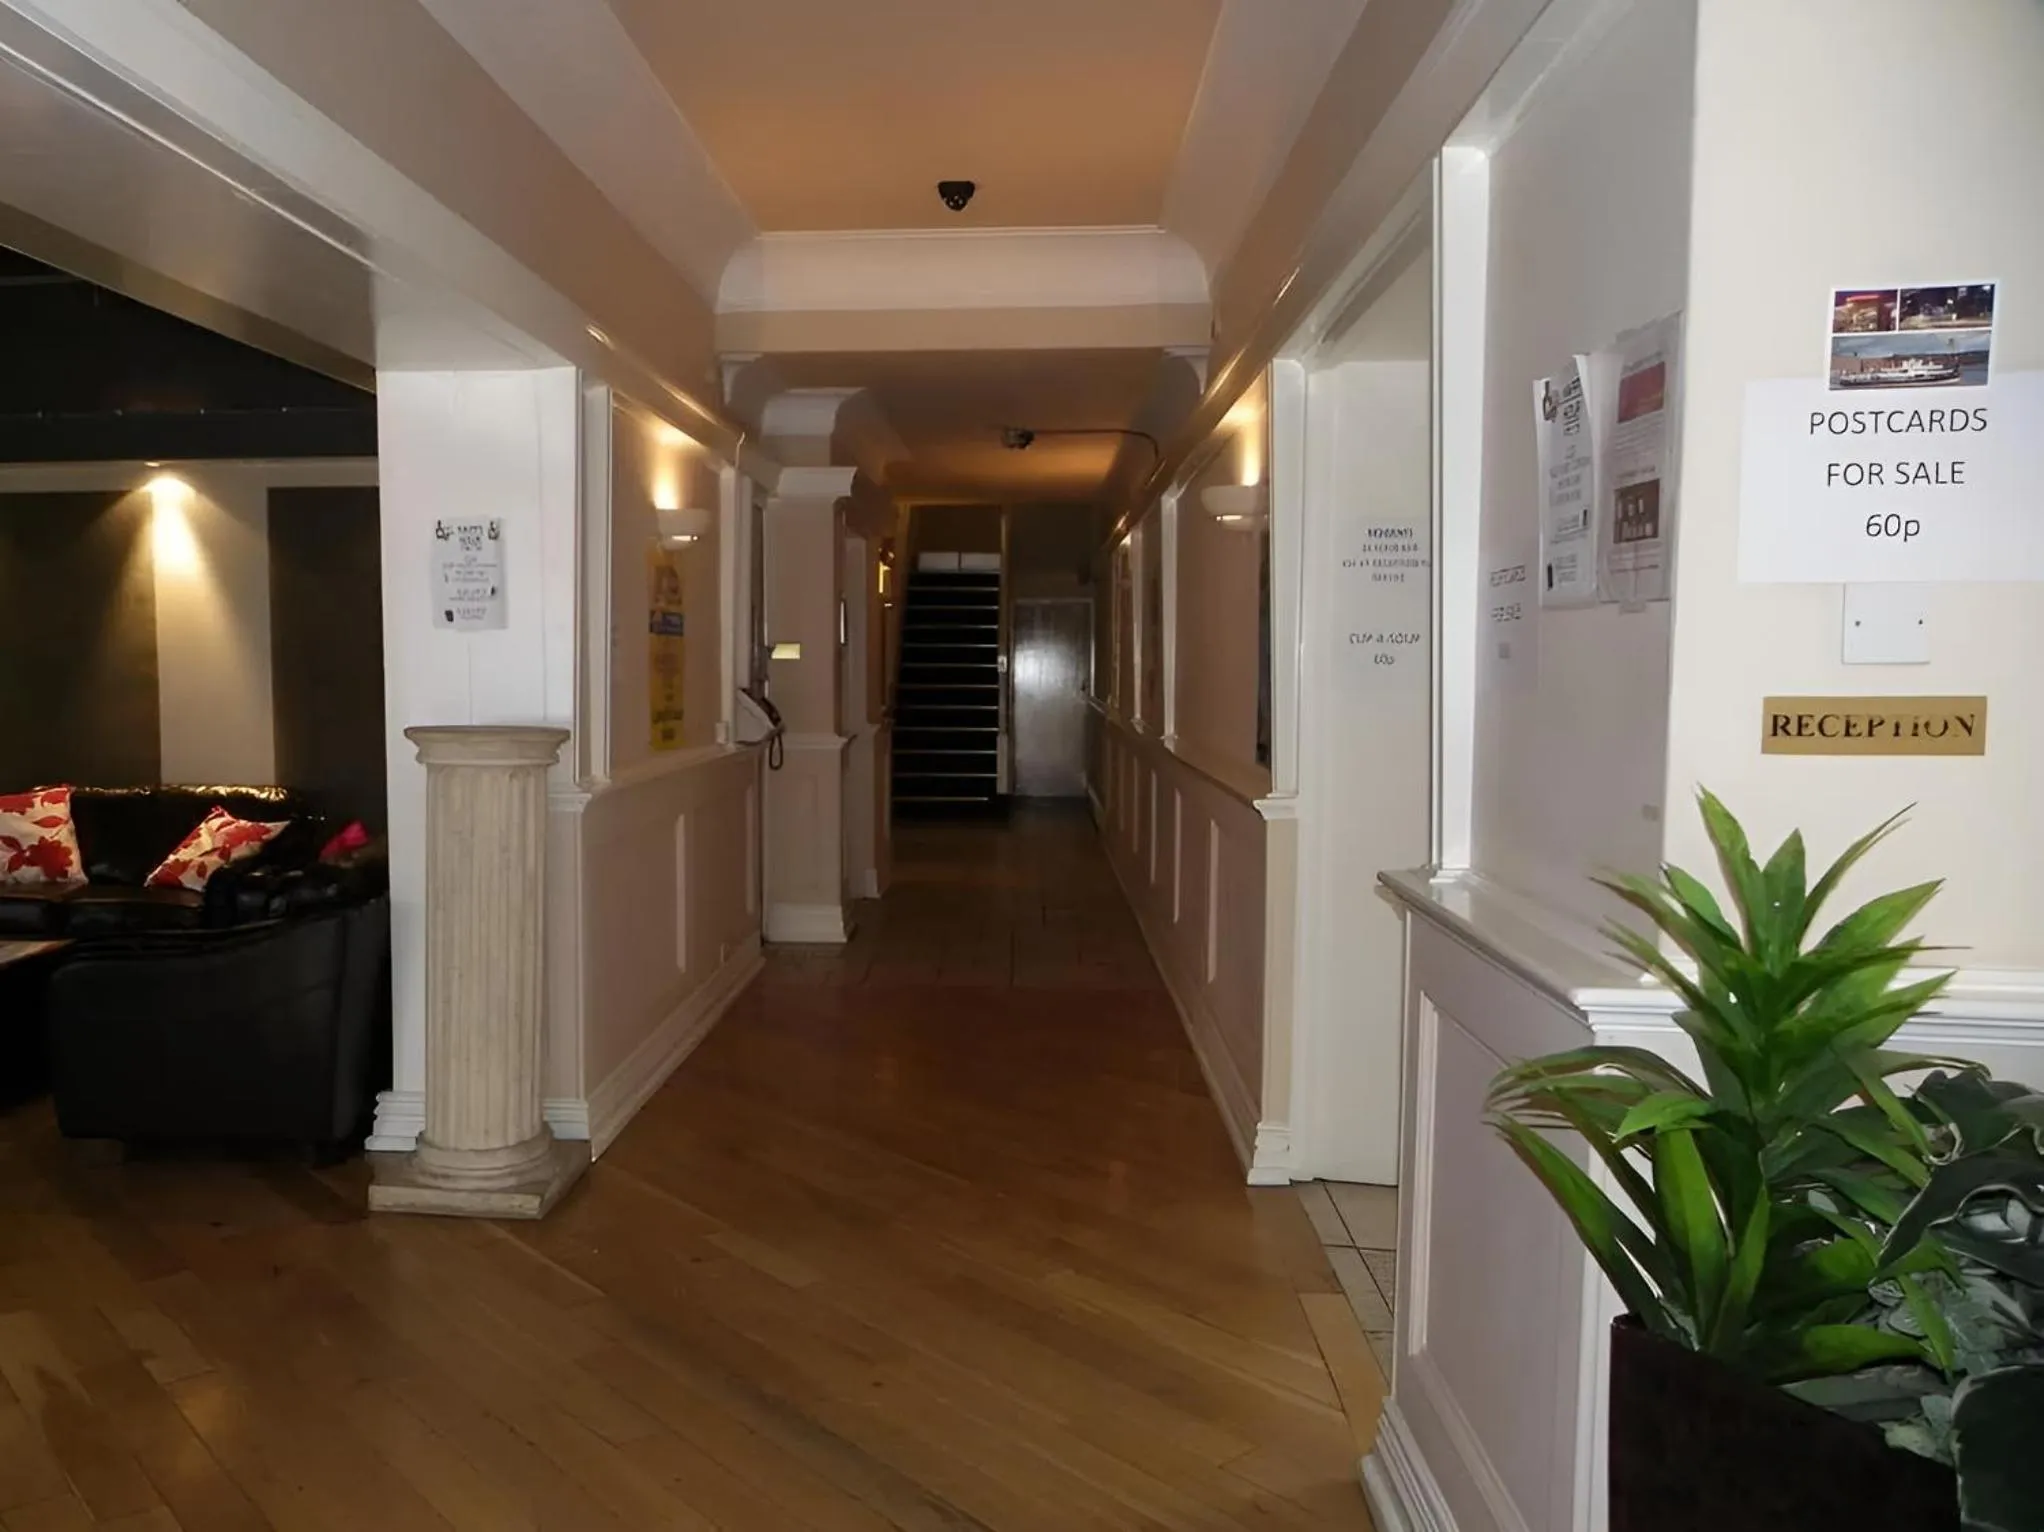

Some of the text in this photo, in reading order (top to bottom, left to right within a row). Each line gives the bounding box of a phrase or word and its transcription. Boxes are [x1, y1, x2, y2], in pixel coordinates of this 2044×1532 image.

[1809, 407, 1988, 436] POSTCARDS
[1826, 460, 1967, 488] FOR SALE
[1865, 512, 1921, 543] 60p
[1769, 713, 1975, 739] RECEPTION
